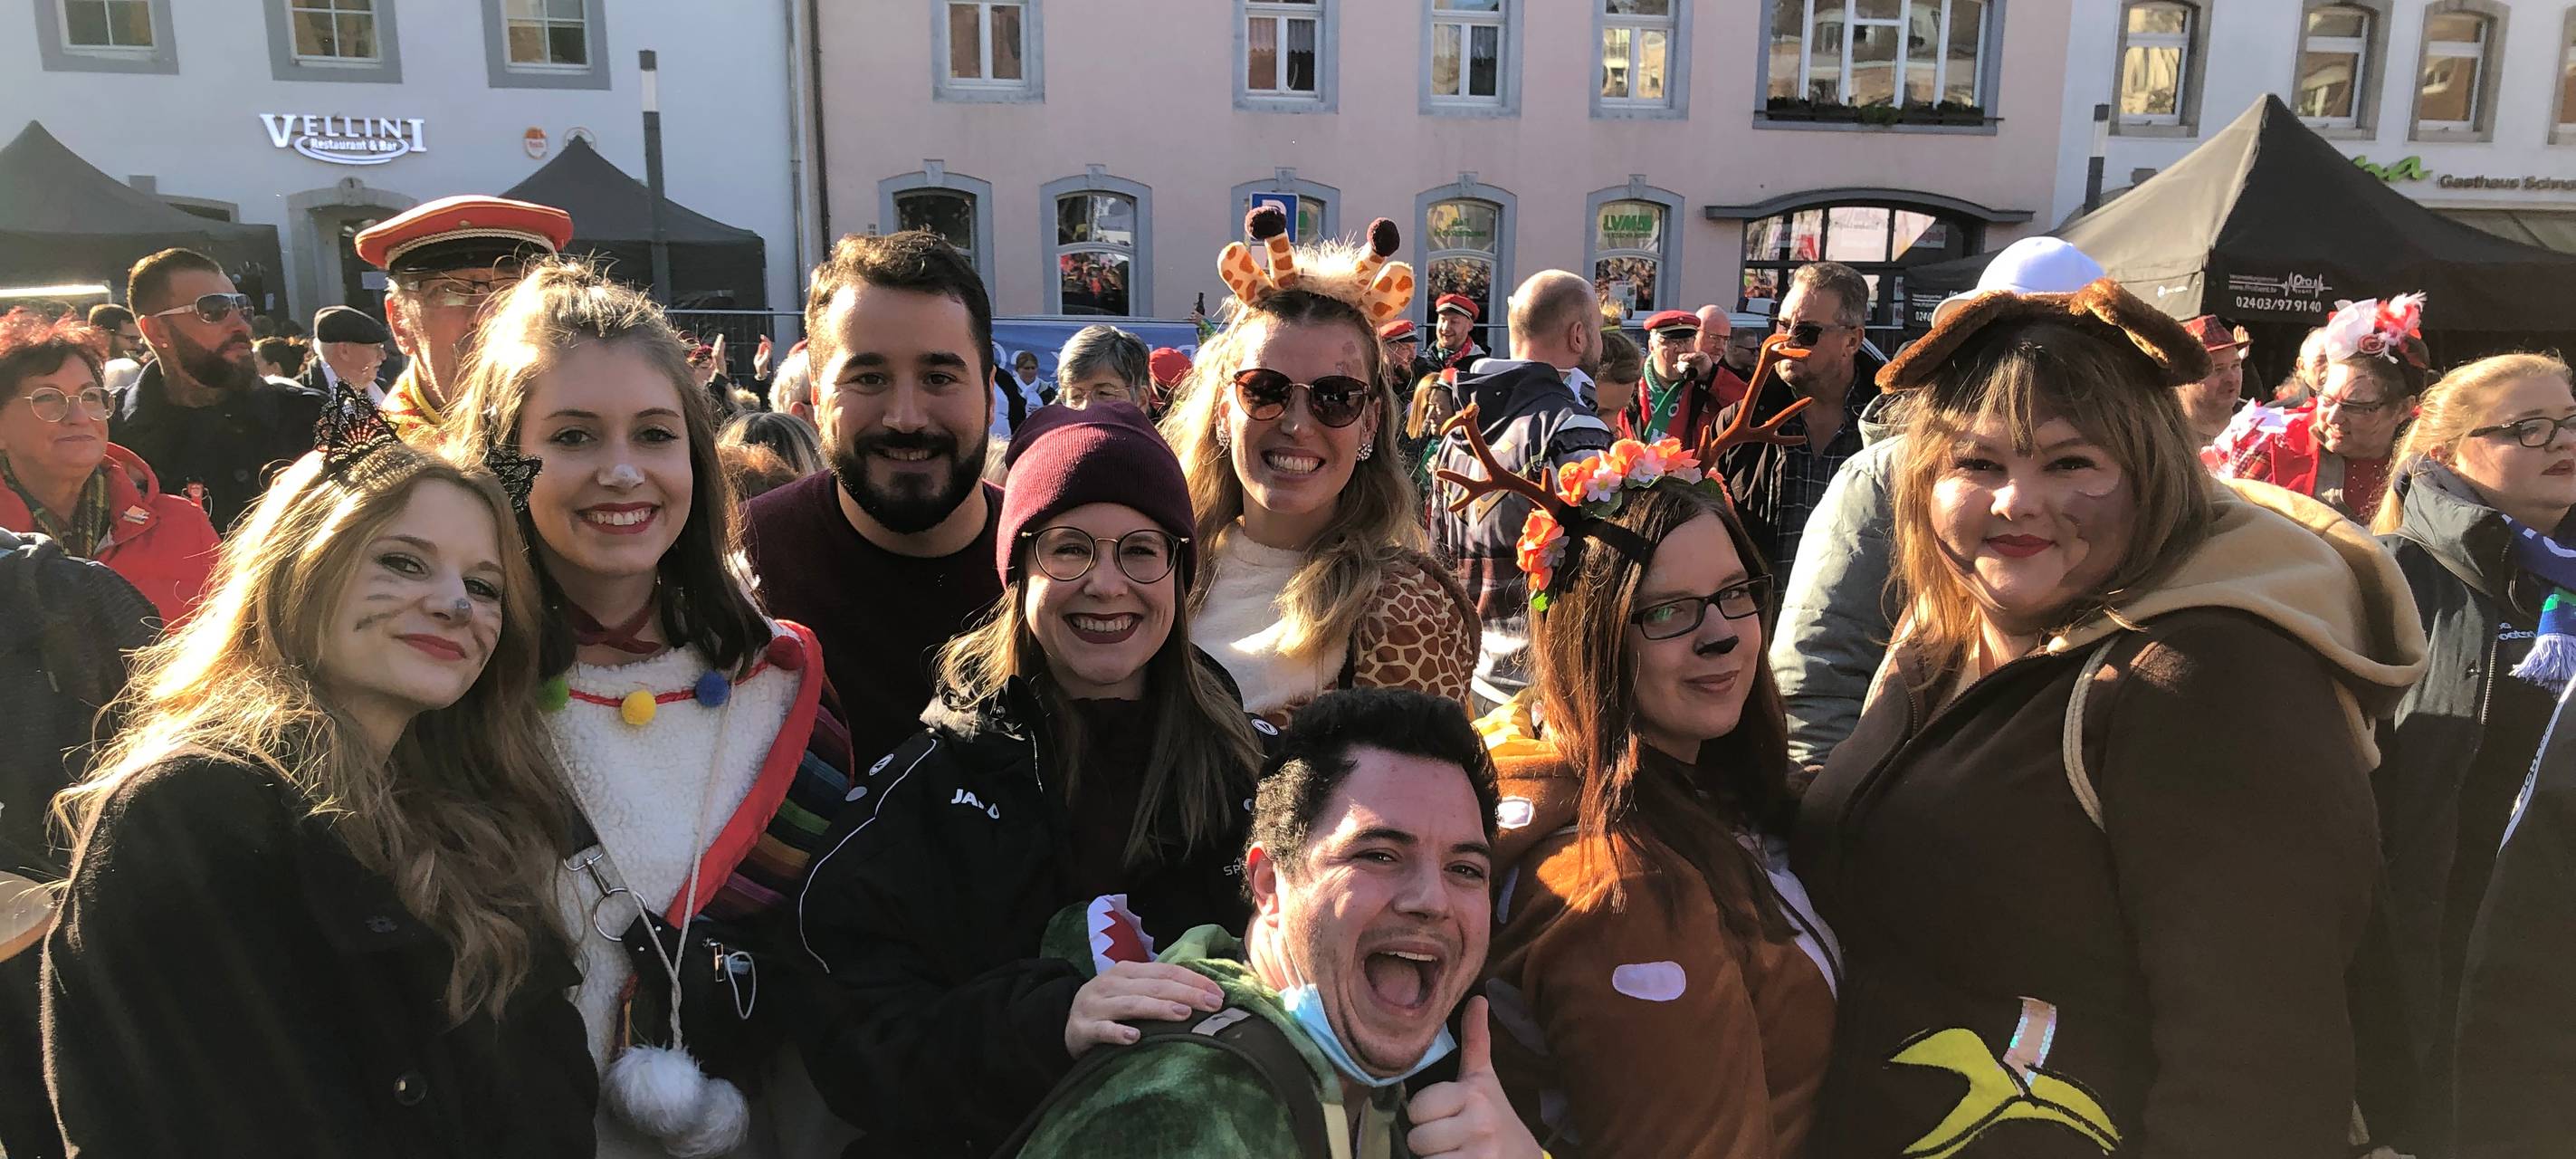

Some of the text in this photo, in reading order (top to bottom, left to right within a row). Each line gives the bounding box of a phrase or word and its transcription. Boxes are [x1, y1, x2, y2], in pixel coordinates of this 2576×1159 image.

[259, 113, 427, 152] VELLINI
[310, 138, 397, 151] Restaurant & Bar
[2439, 174, 2520, 189] Gasthaus
[950, 788, 1000, 819] JAO
